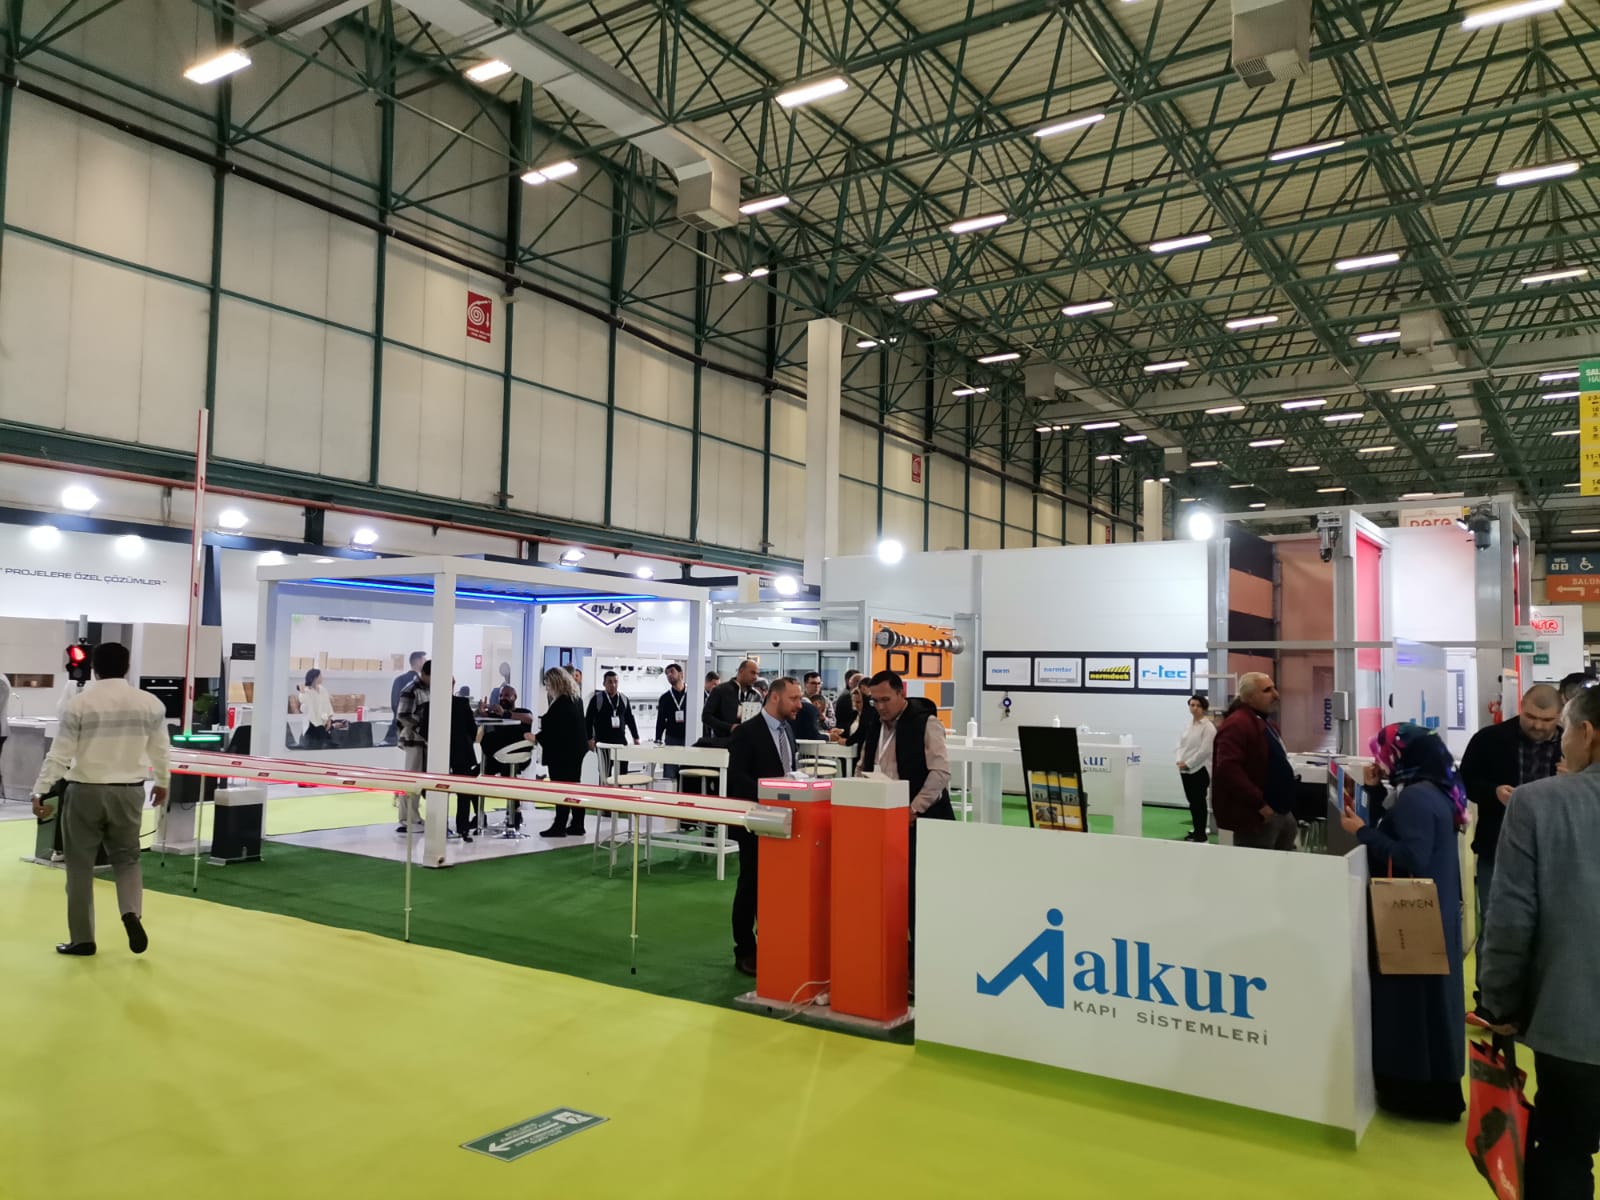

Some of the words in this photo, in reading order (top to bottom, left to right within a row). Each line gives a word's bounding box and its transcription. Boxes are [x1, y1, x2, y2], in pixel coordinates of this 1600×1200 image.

[5, 568, 72, 579] PROJELERE
[74, 572, 102, 581] ÖZEL
[103, 574, 161, 586] ÇÖZÜMLER
[591, 602, 622, 616] ay-ka
[614, 624, 635, 634] door
[1142, 665, 1187, 679] r-tec
[1392, 899, 1434, 909] ARVEN
[1073, 937, 1268, 1019] alkur
[1073, 1000, 1117, 1019] KAPI
[1136, 1009, 1269, 1046] SİSTEMLERİ
